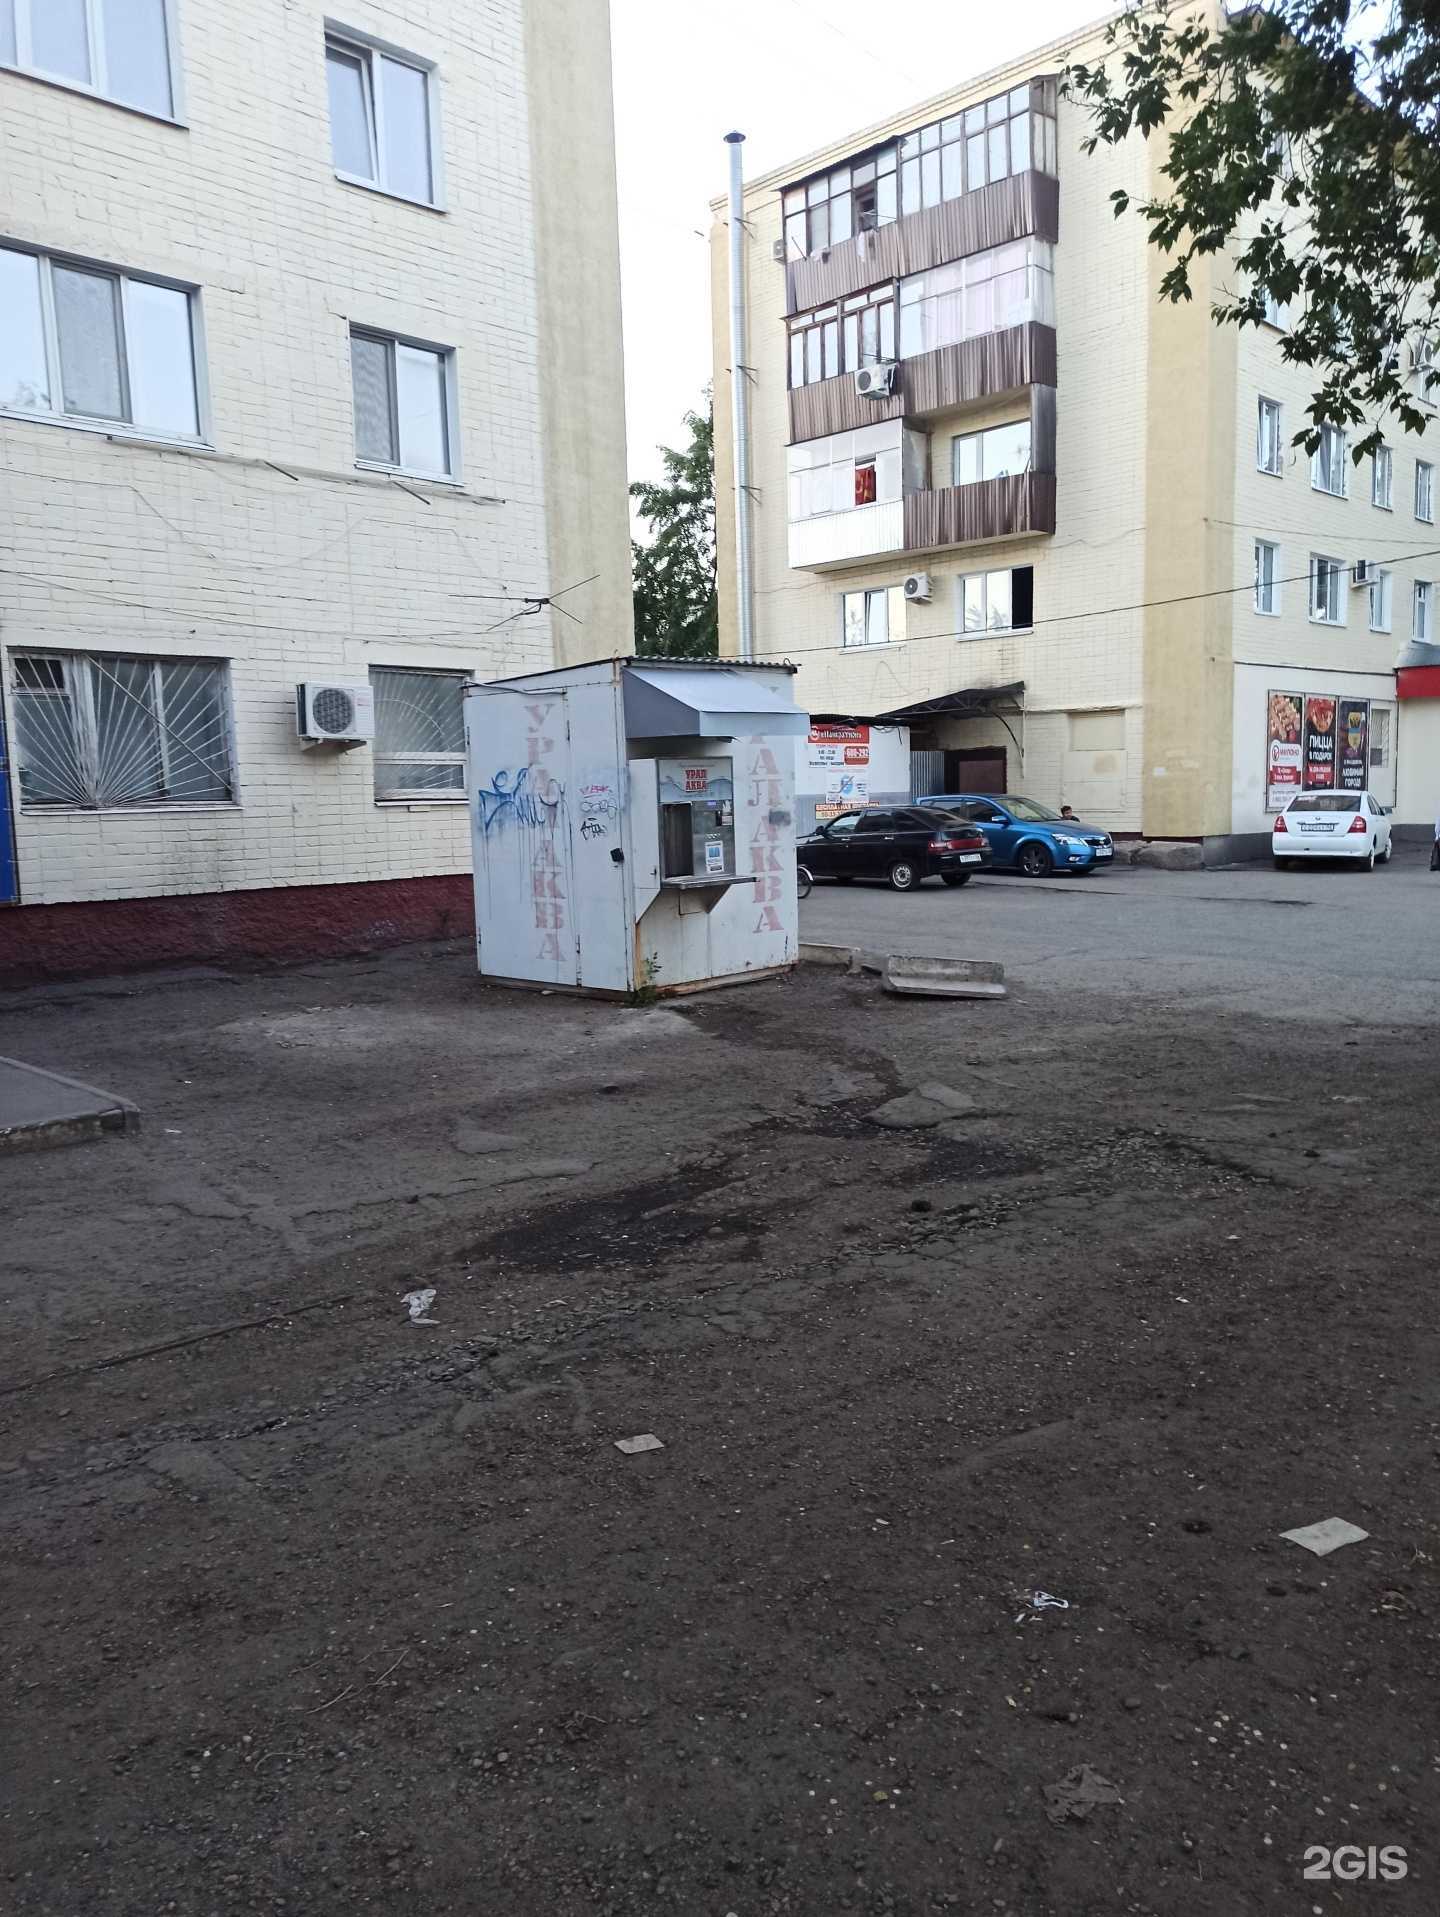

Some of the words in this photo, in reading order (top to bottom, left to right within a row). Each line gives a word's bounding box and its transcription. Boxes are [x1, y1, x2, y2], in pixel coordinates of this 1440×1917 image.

[1309, 735, 1333, 750] ПИЦЦА
[1313, 751, 1333, 761] ПОДАРОК
[685, 769, 707, 779] УРАЛ
[685, 781, 707, 791] АКВА
